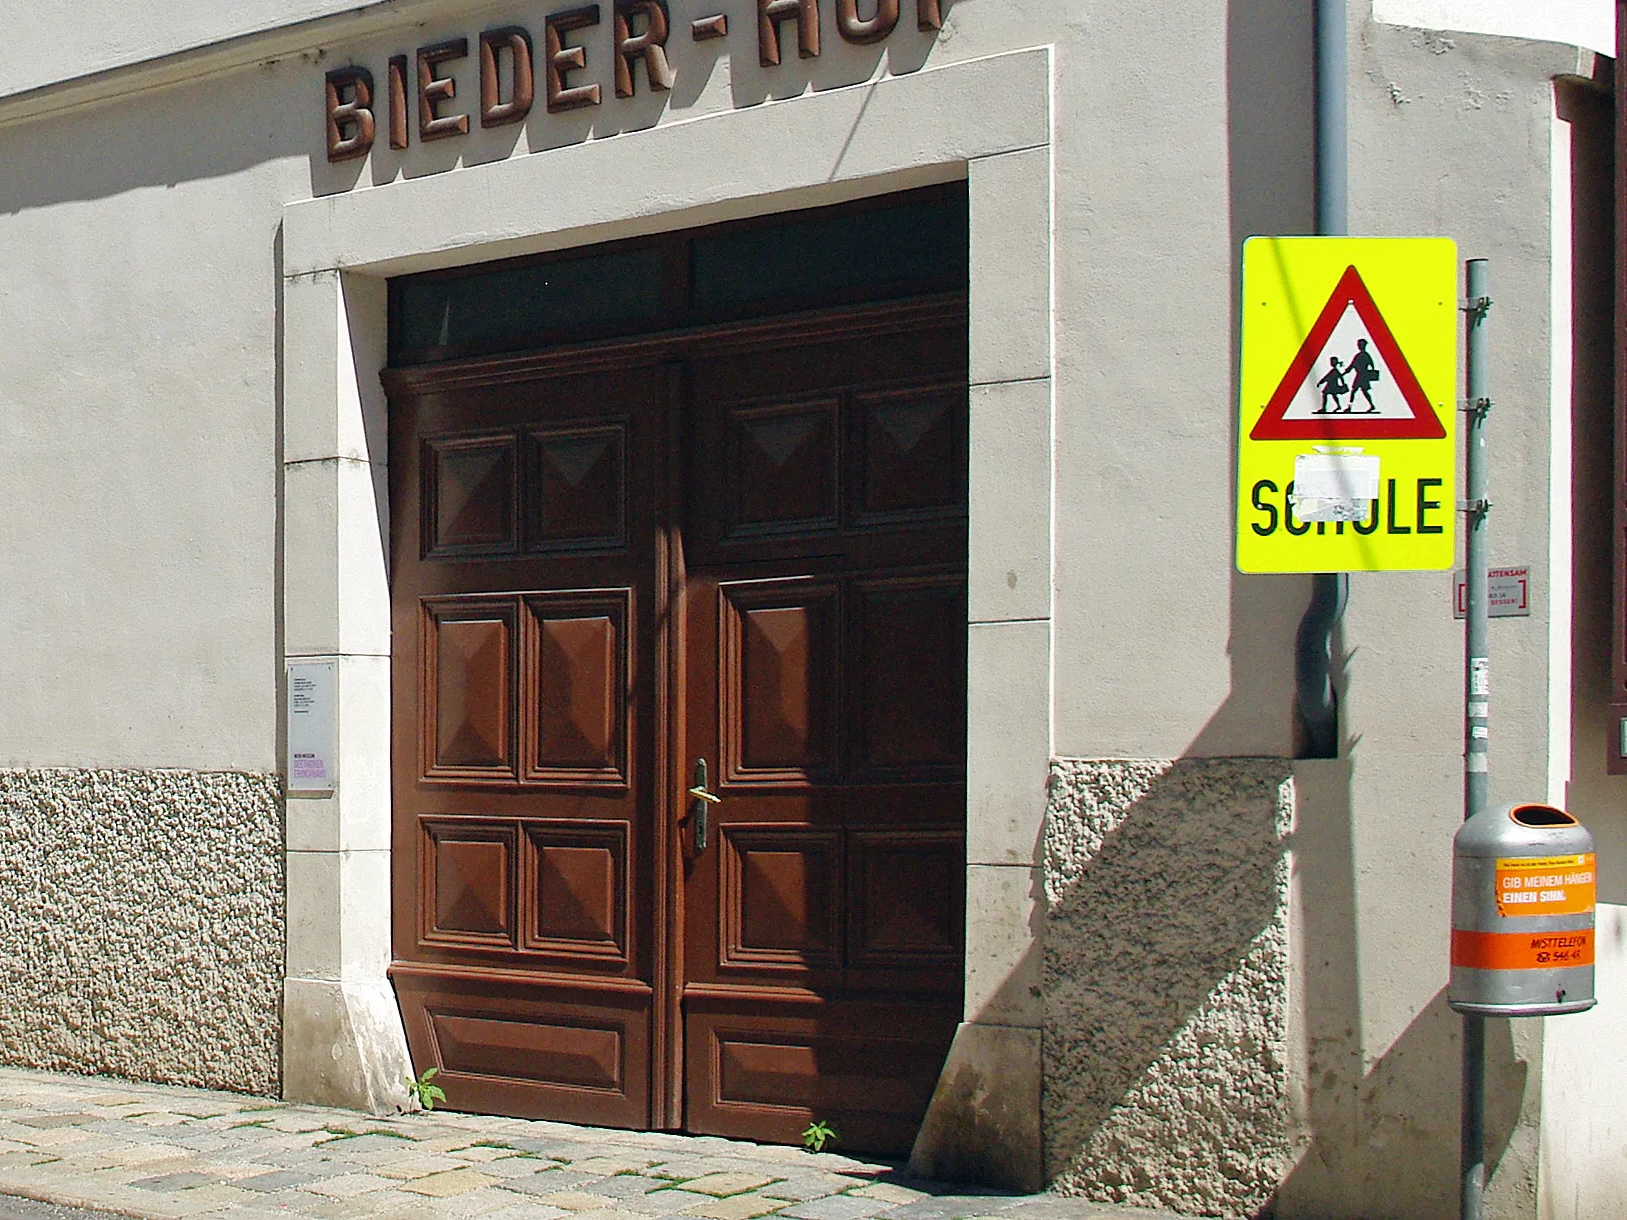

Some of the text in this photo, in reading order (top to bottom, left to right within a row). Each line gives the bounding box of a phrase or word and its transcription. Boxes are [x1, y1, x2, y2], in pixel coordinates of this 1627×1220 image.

[1250, 477, 1444, 538] SCULE
[1502, 877, 1522, 888] GIB
[1524, 874, 1564, 888] MEINEM
[1502, 892, 1537, 903] EINEN
